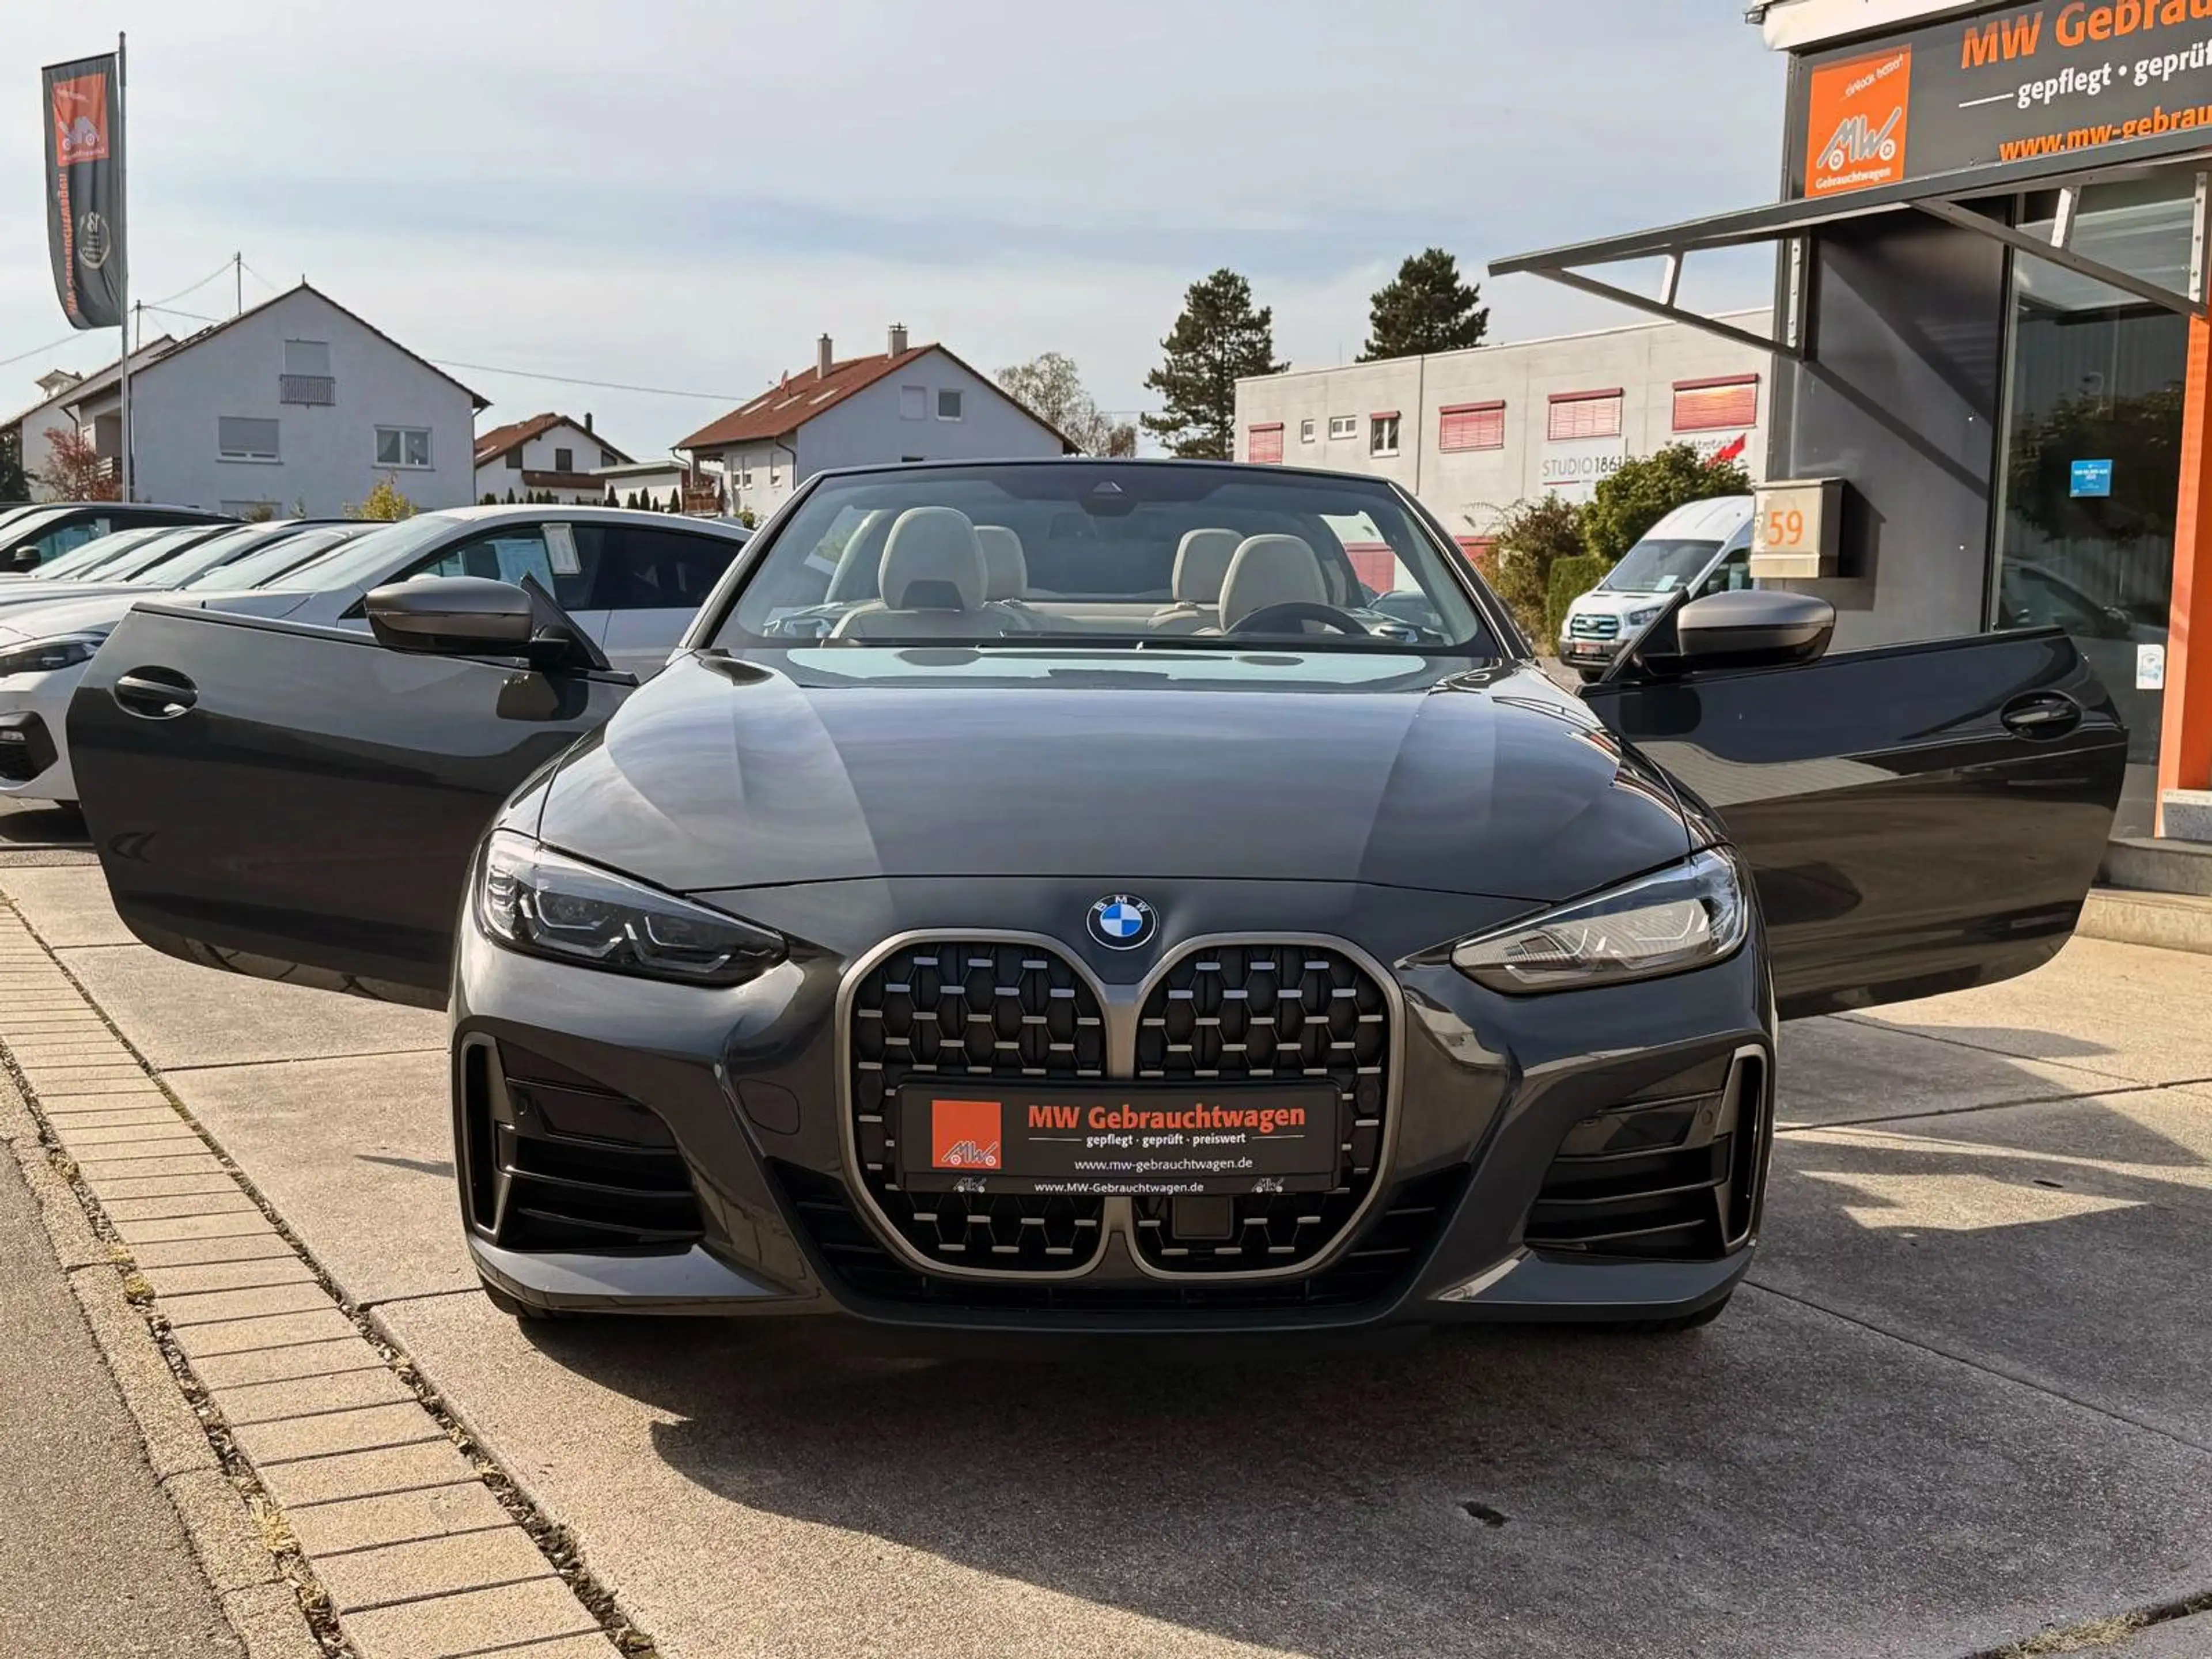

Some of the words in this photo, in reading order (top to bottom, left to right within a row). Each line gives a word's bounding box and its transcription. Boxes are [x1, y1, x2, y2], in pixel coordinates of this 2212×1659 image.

[1961, 11, 2044, 69] MW
[2055, 0, 2212, 47] Gebrau
[2017, 62, 2112, 109] gepflegt
[1816, 168, 1892, 189] Gebrauchtwagen
[1543, 457, 1594, 477] STUDIO
[1768, 510, 1804, 546] 59
[1093, 896, 1151, 912] BMW
[1028, 1104, 1081, 1129] MW
[1088, 1103, 1306, 1134] Gebrauchtwagen
[1086, 1134, 1132, 1149] gepflegt
[1142, 1134, 1184, 1149] geprüft
[1192, 1132, 1247, 1147] preiswert
[1074, 1156, 1253, 1173] www.mw-gebrauchtwagen.de
[1035, 1182, 1204, 1195] www.MW-Gebrauchtwagen.de
